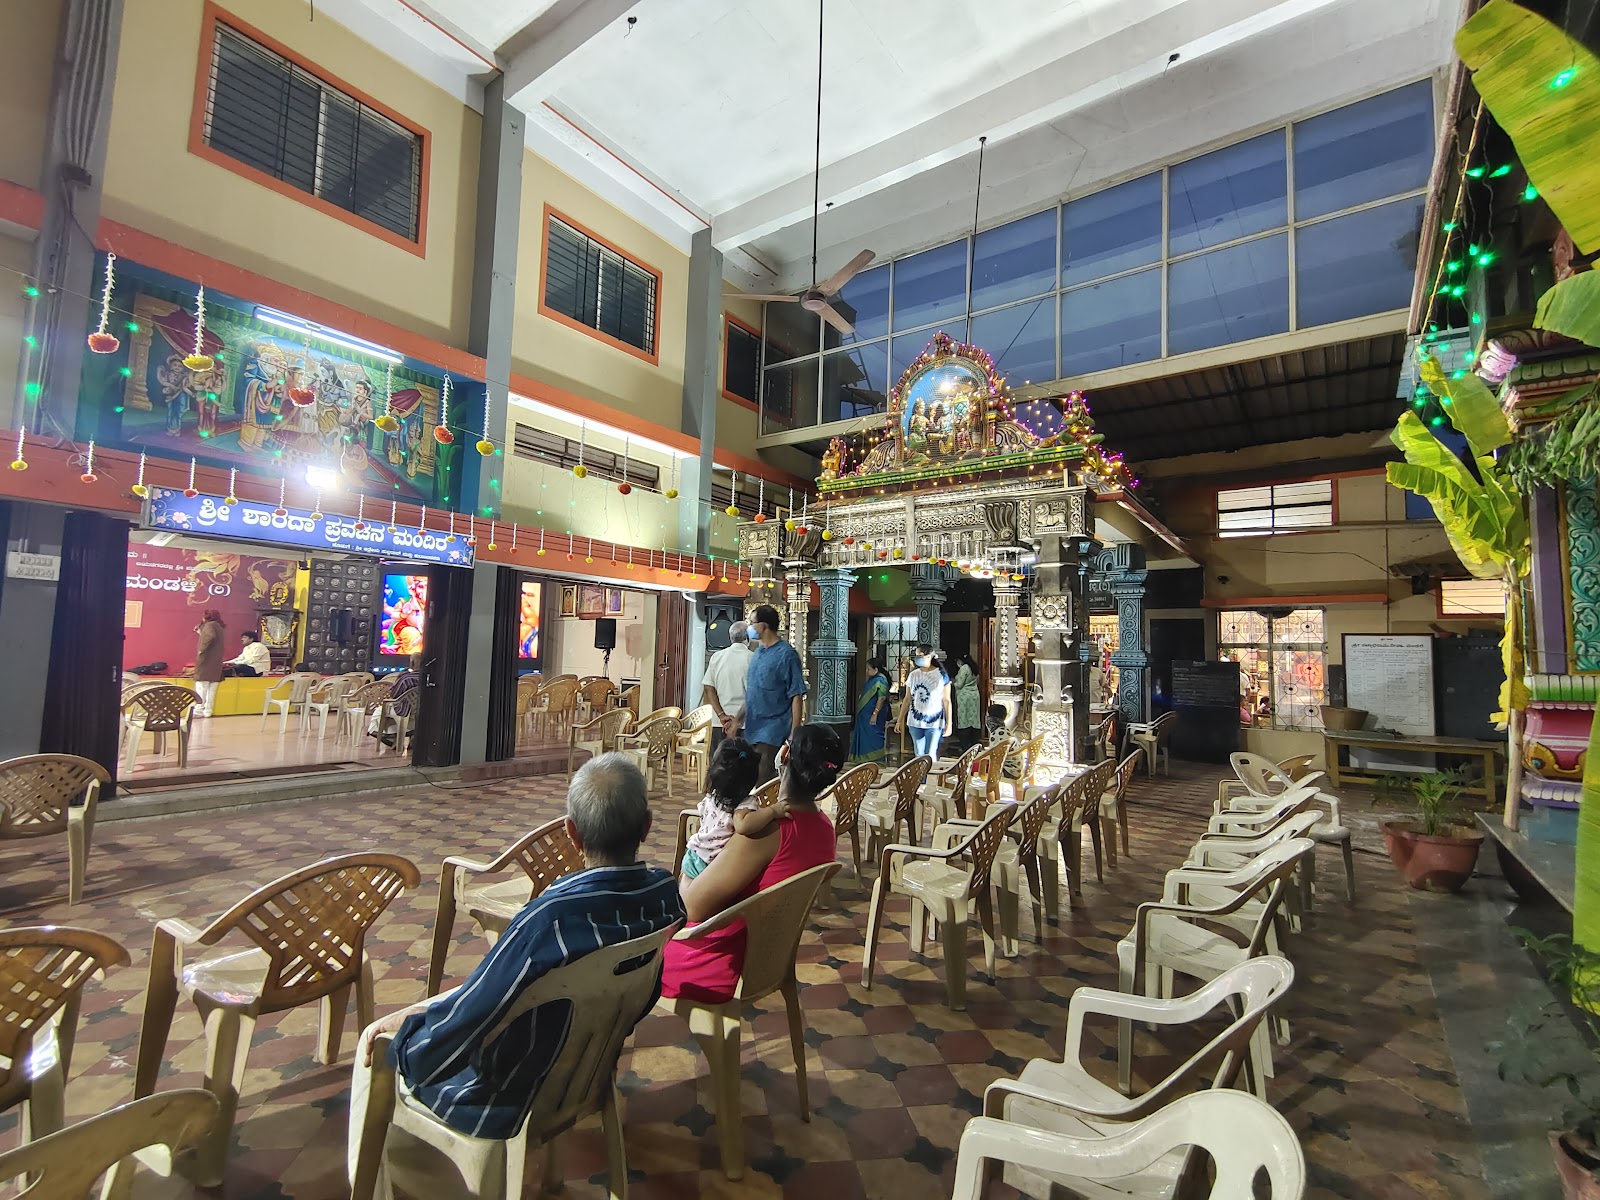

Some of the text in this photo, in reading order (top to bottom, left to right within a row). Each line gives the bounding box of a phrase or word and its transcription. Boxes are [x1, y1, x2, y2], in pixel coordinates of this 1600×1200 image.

[196, 498, 448, 551] ಶ್ರೀ ಶಾರದಾ ಪ್ರವಚನ ಮಂದಿರ
